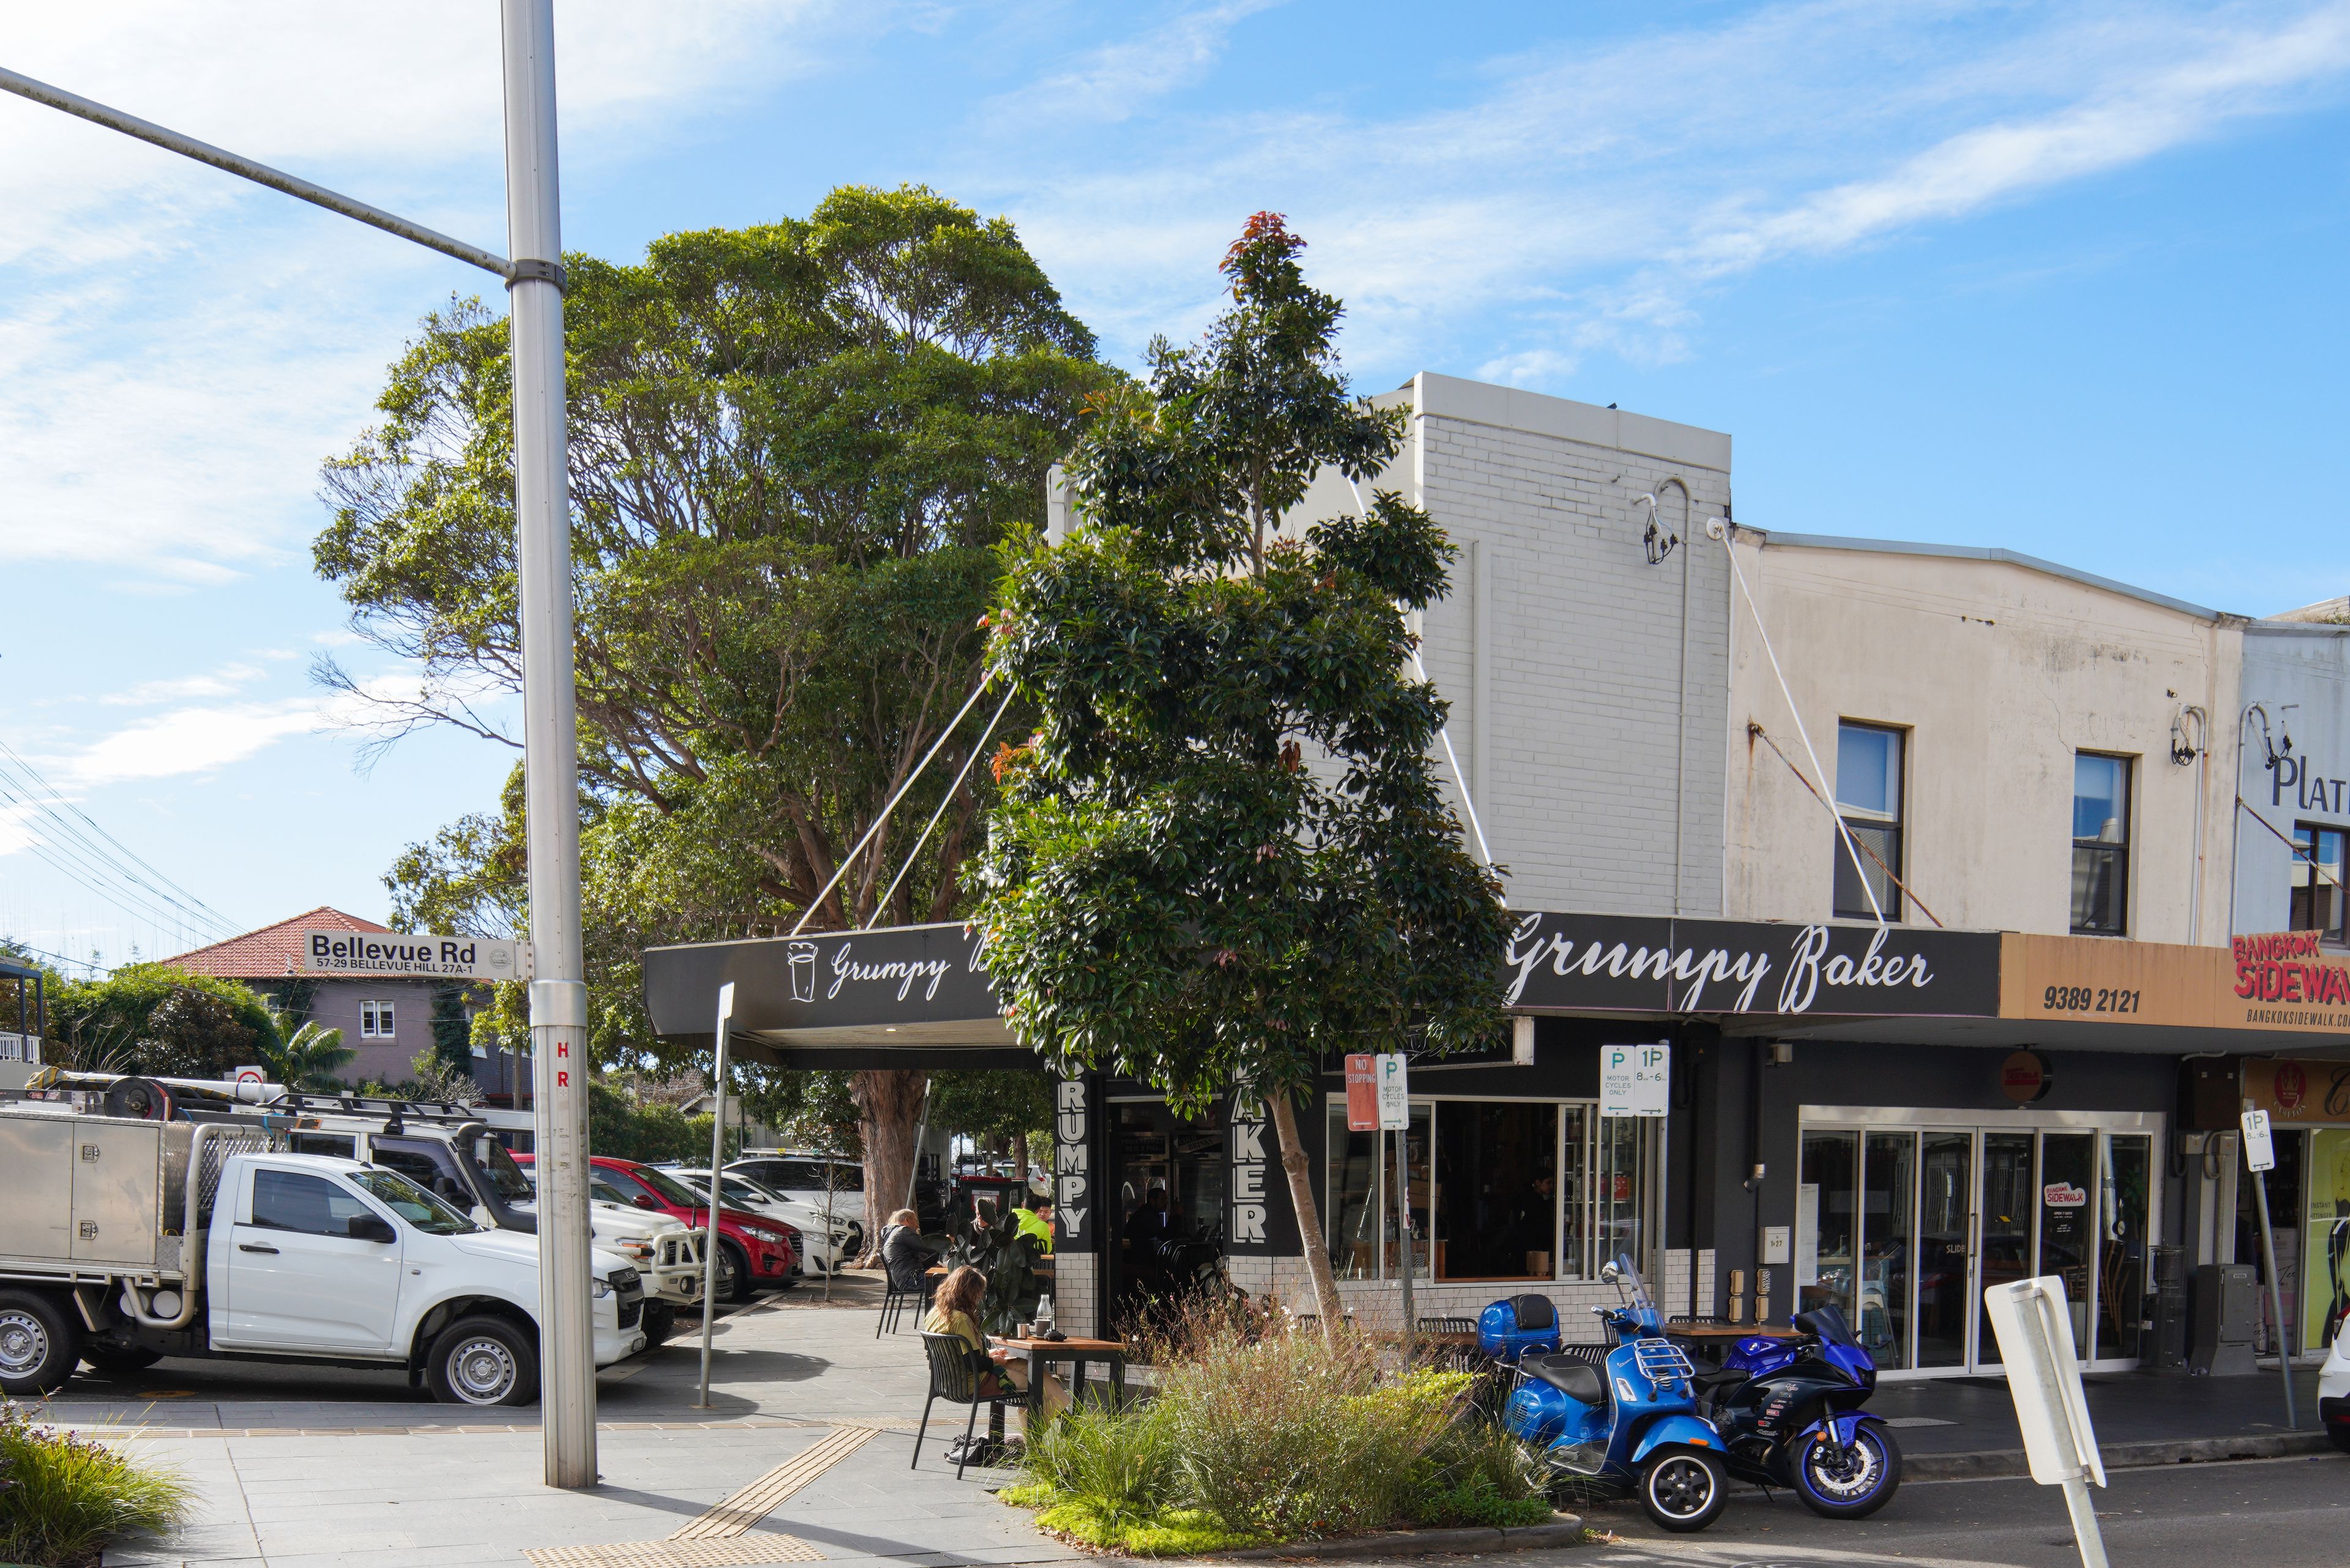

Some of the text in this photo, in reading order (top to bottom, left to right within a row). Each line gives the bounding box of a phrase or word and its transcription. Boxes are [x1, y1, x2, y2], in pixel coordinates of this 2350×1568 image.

[2272, 755, 2350, 815] PLAT
[312, 935, 432, 962] Bellevue
[441, 941, 476, 965] Rd
[2232, 932, 2320, 962] BANGKOK
[316, 958, 472, 974] 57-29 BELLEVUE HILL 27A-1
[828, 943, 951, 1001] Grumpy
[1501, 912, 1934, 1015] Grumpy Baker
[2043, 986, 2140, 1014] 9389 2121
[1355, 1059, 1367, 1070] NO
[1612, 1053, 1625, 1069] P
[1642, 1050, 1663, 1067] 1P
[1348, 1073, 1376, 1084] STOPPING
[1386, 1061, 1398, 1080] P
[2247, 1114, 2263, 1130] 1P
[1230, 1062, 1267, 1243] AKER
[2046, 1185, 2067, 1194] BANGKOK
[1945, 1244, 1966, 1254] SLIDE
